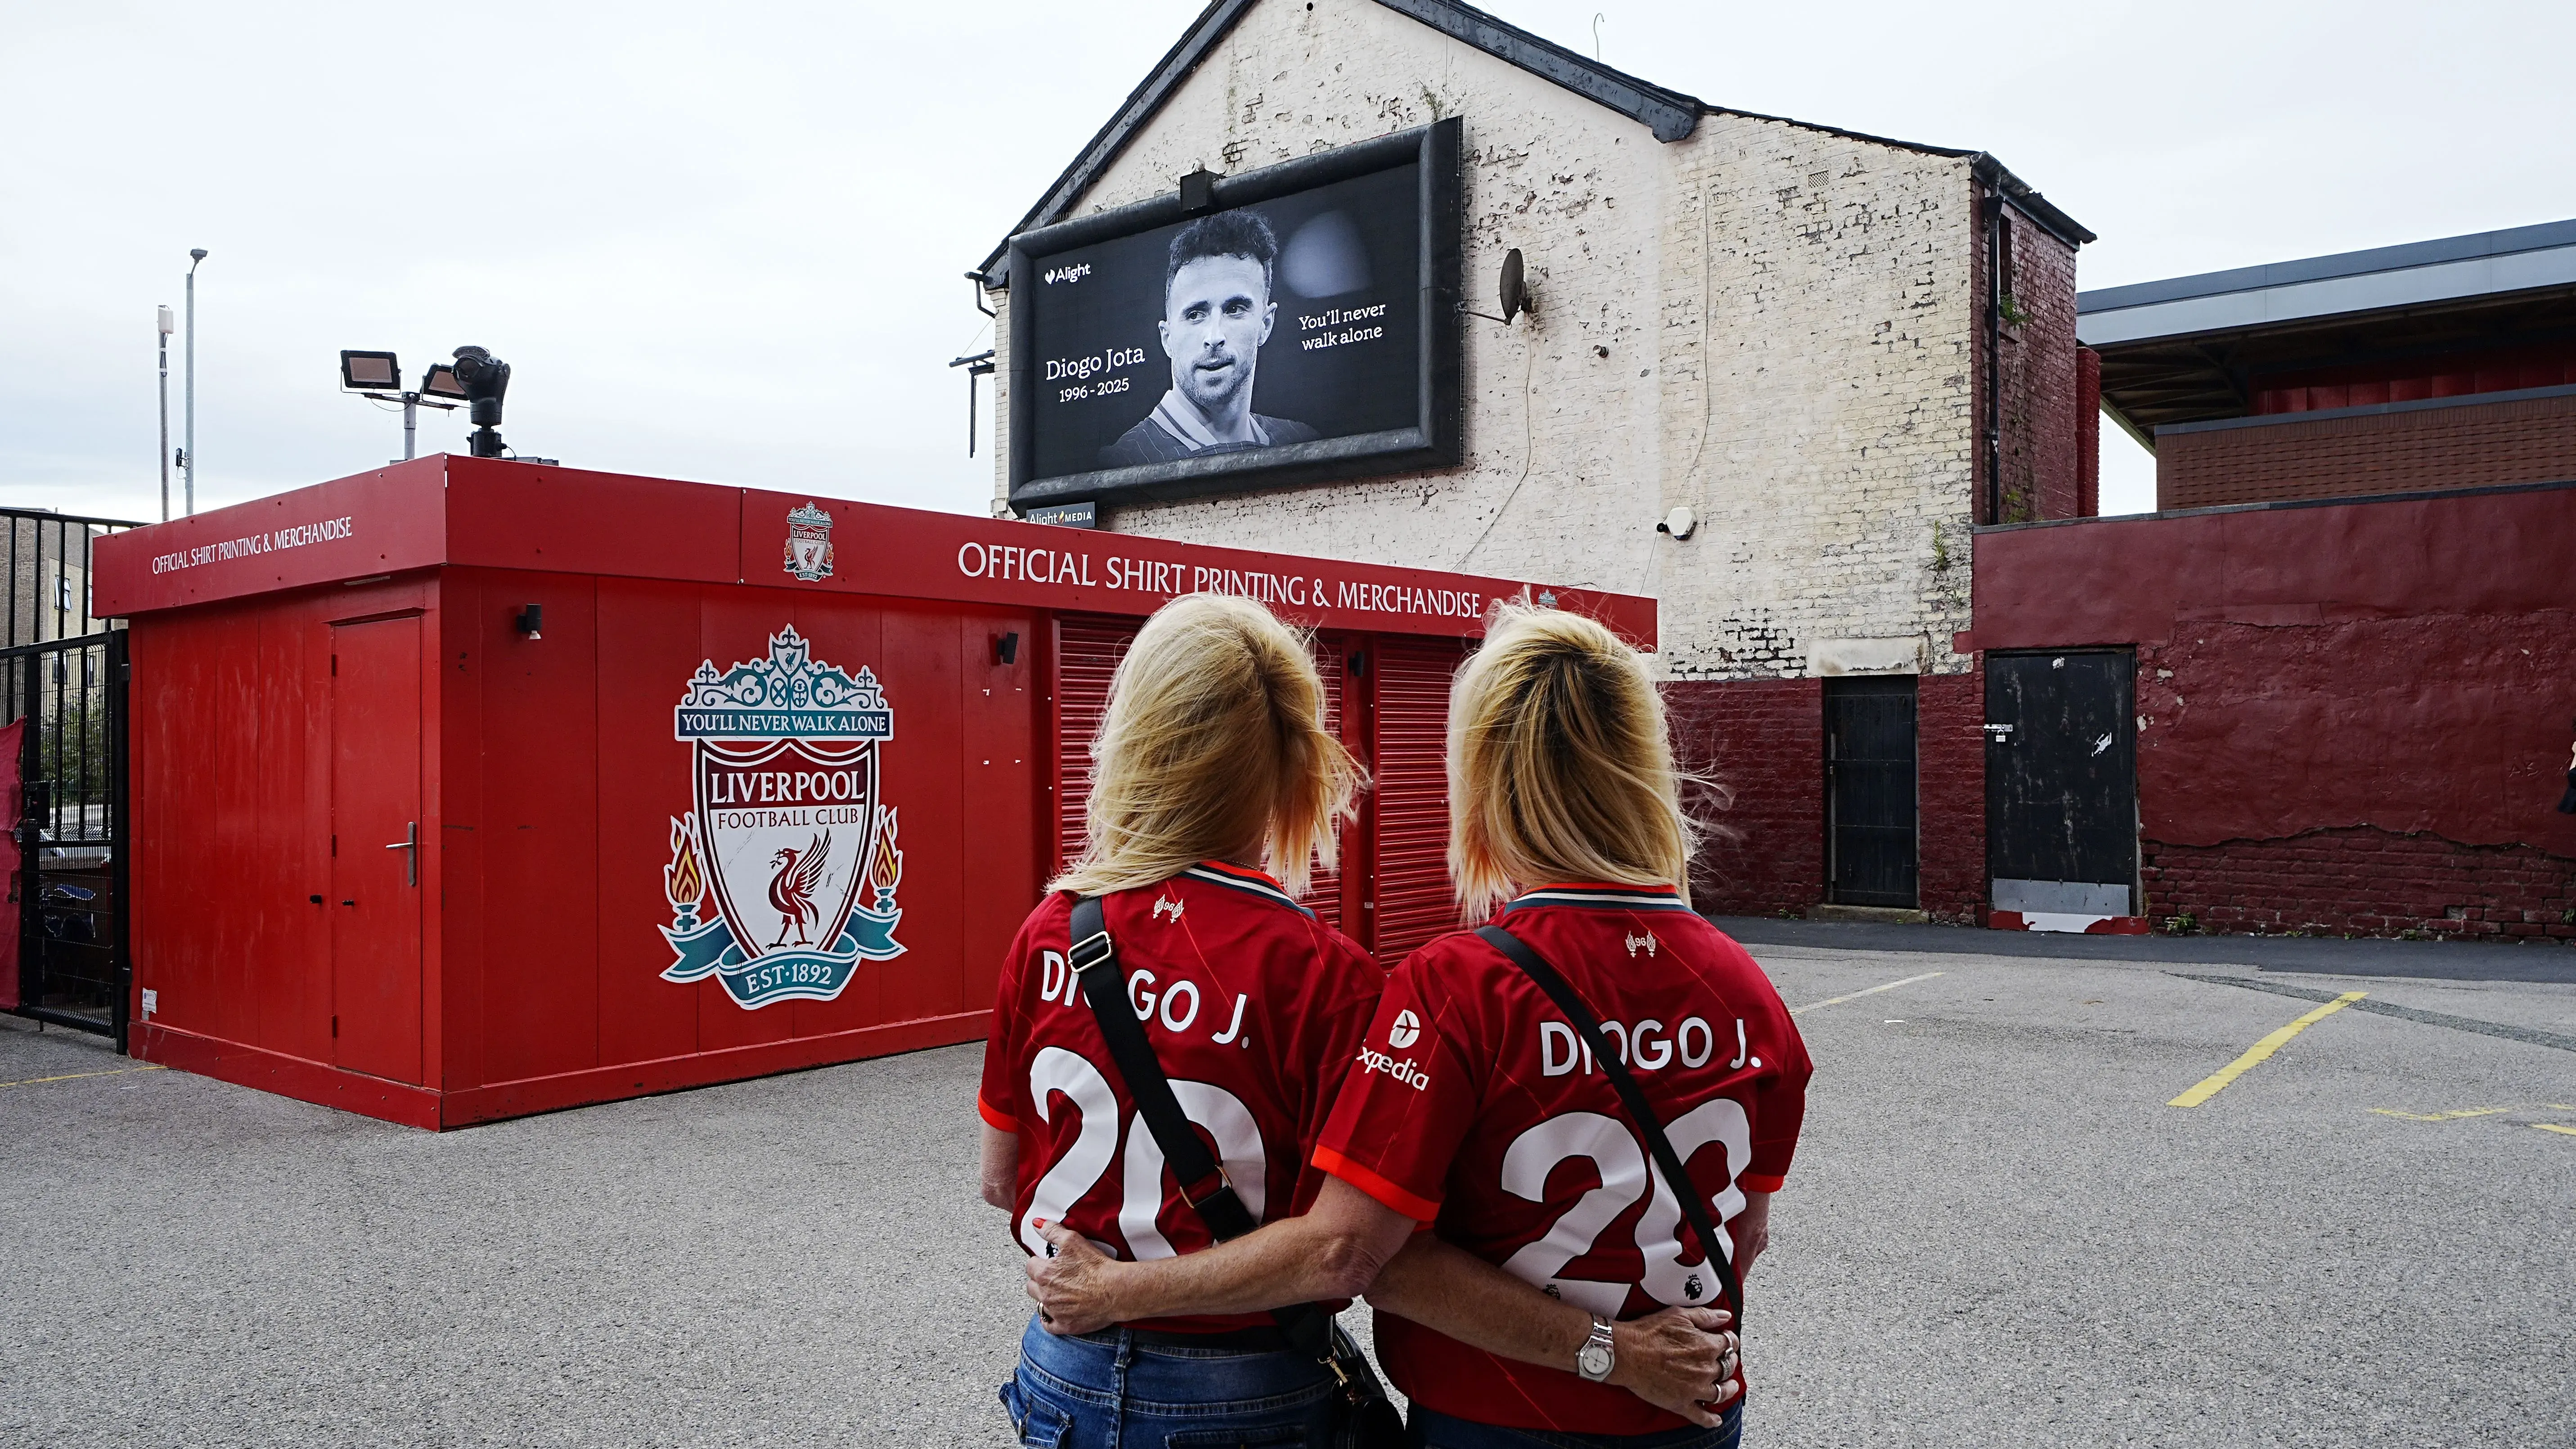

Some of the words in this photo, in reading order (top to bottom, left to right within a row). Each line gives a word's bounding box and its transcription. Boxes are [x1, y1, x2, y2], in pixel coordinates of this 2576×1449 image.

[1055, 263, 1091, 283] Alight
[1298, 309, 1340, 330] You'll
[1343, 304, 1386, 323] never
[1301, 331, 1338, 351] walk
[1340, 326, 1383, 344] alone
[1046, 356, 1102, 380] Diogo
[1106, 347, 1146, 373] Jota
[1030, 511, 1057, 525] Alight
[1065, 511, 1092, 522] MEDIA
[152, 551, 189, 575] OFFICIAL
[191, 544, 217, 567] SHIRT
[218, 534, 261, 561] PRINTING
[263, 533, 273, 552] &
[274, 516, 352, 550] MERCHANDISE
[793, 530, 826, 540] LIVERPOOL
[958, 542, 1097, 586] OFFICIAL
[1105, 556, 1186, 594] SHIRT
[1194, 566, 1305, 605] PRINTING
[1313, 578, 1331, 608] &
[1337, 580, 1482, 618] MERCHANDISE
[681, 714, 736, 731] YOU'LL
[739, 715, 791, 731] NEVER
[791, 716, 837, 731] WALK
[838, 716, 886, 732] ALONE
[711, 771, 865, 803] LIVERPOOL
[718, 810, 810, 829] FOOTBALL
[815, 808, 859, 825] CLUB
[1163, 901, 1174, 911] 96
[1635, 937, 1646, 946] 96
[1041, 950, 1200, 1032] DIGO
[1211, 993, 1249, 1049] J.
[1730, 1018, 1763, 1069] J.
[1356, 1039, 1430, 1091] xpedia
[1020, 1046, 1266, 1262] 20
[1499, 1098, 1752, 1320] 20
